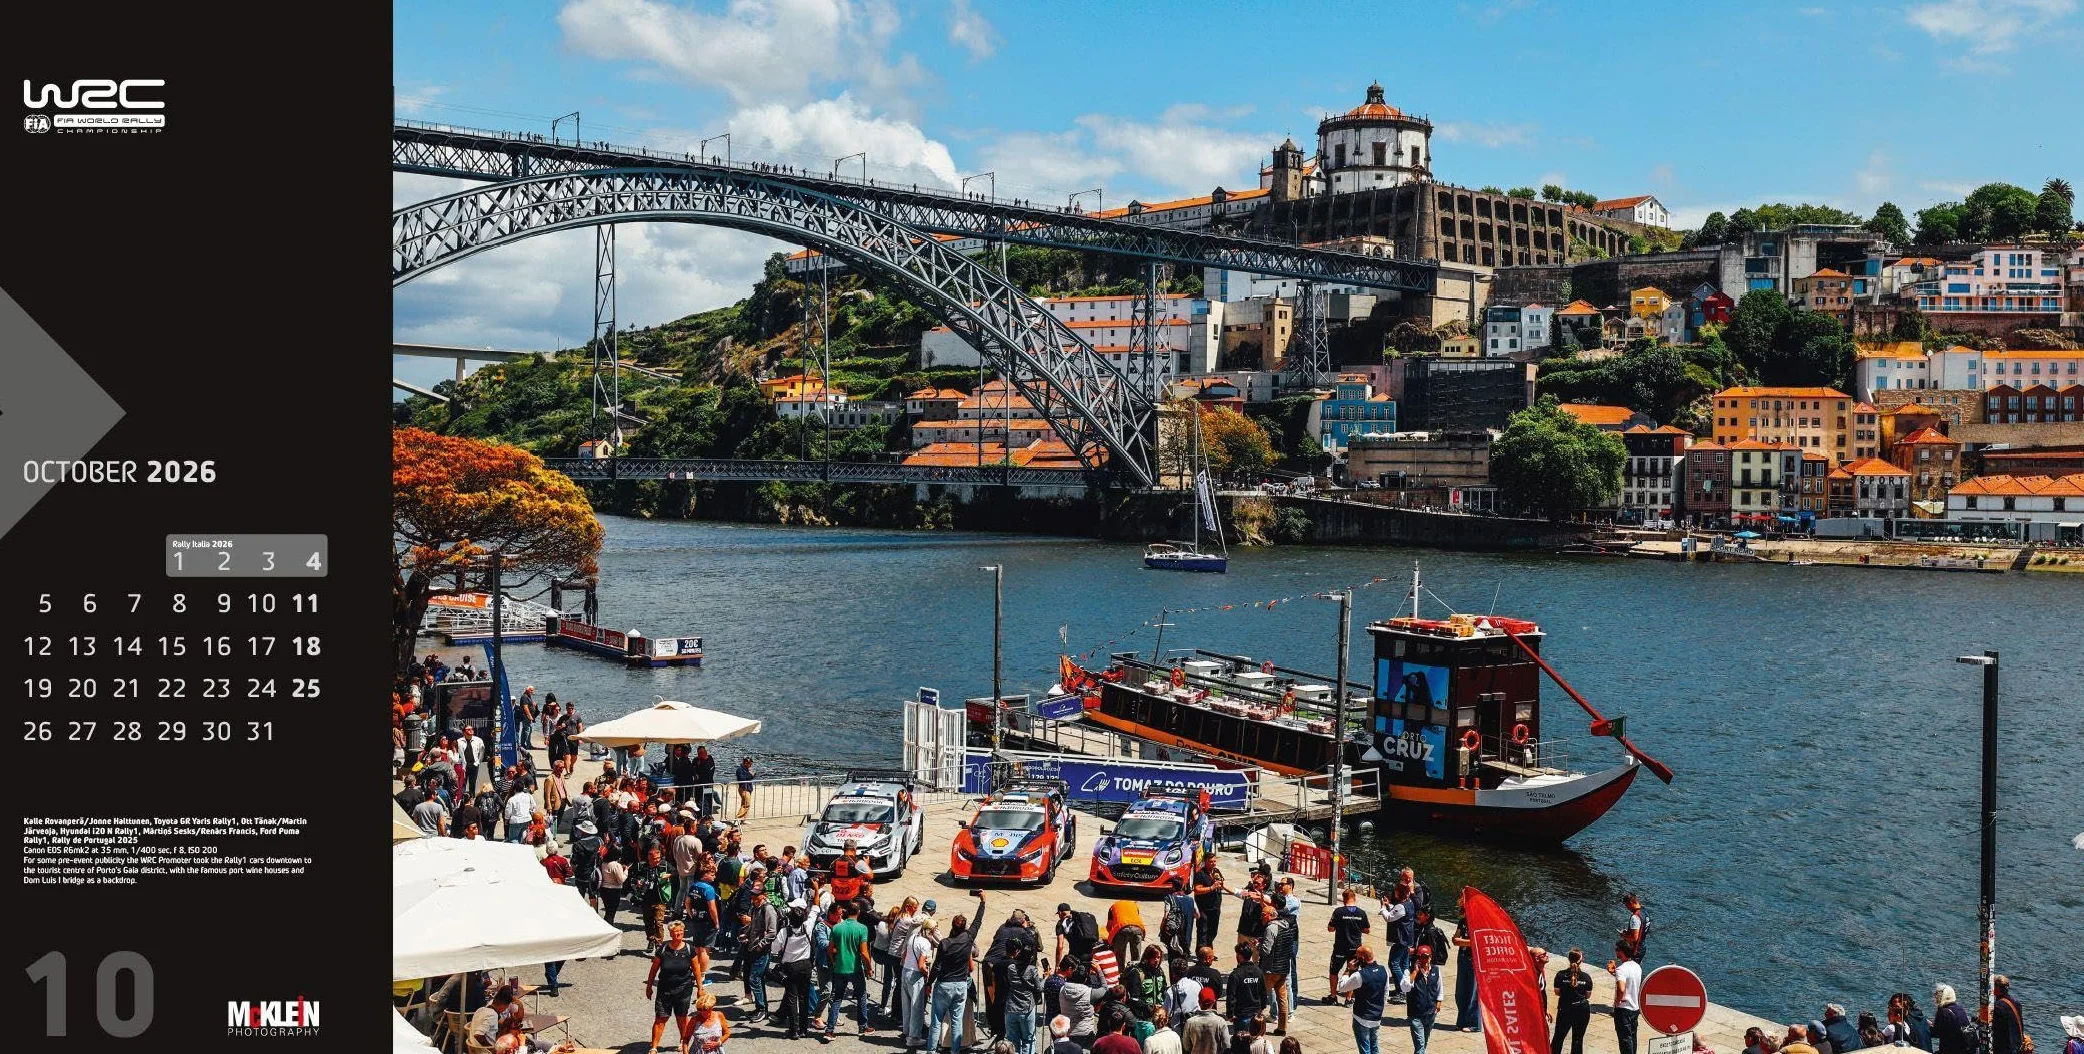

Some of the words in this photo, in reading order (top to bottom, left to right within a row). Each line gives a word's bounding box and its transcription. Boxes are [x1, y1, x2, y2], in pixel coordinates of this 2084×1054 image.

[1859, 475, 1905, 485] SPORT
[1383, 736, 1435, 762] CRUZ
[1114, 777, 1163, 792] TOMAZ
